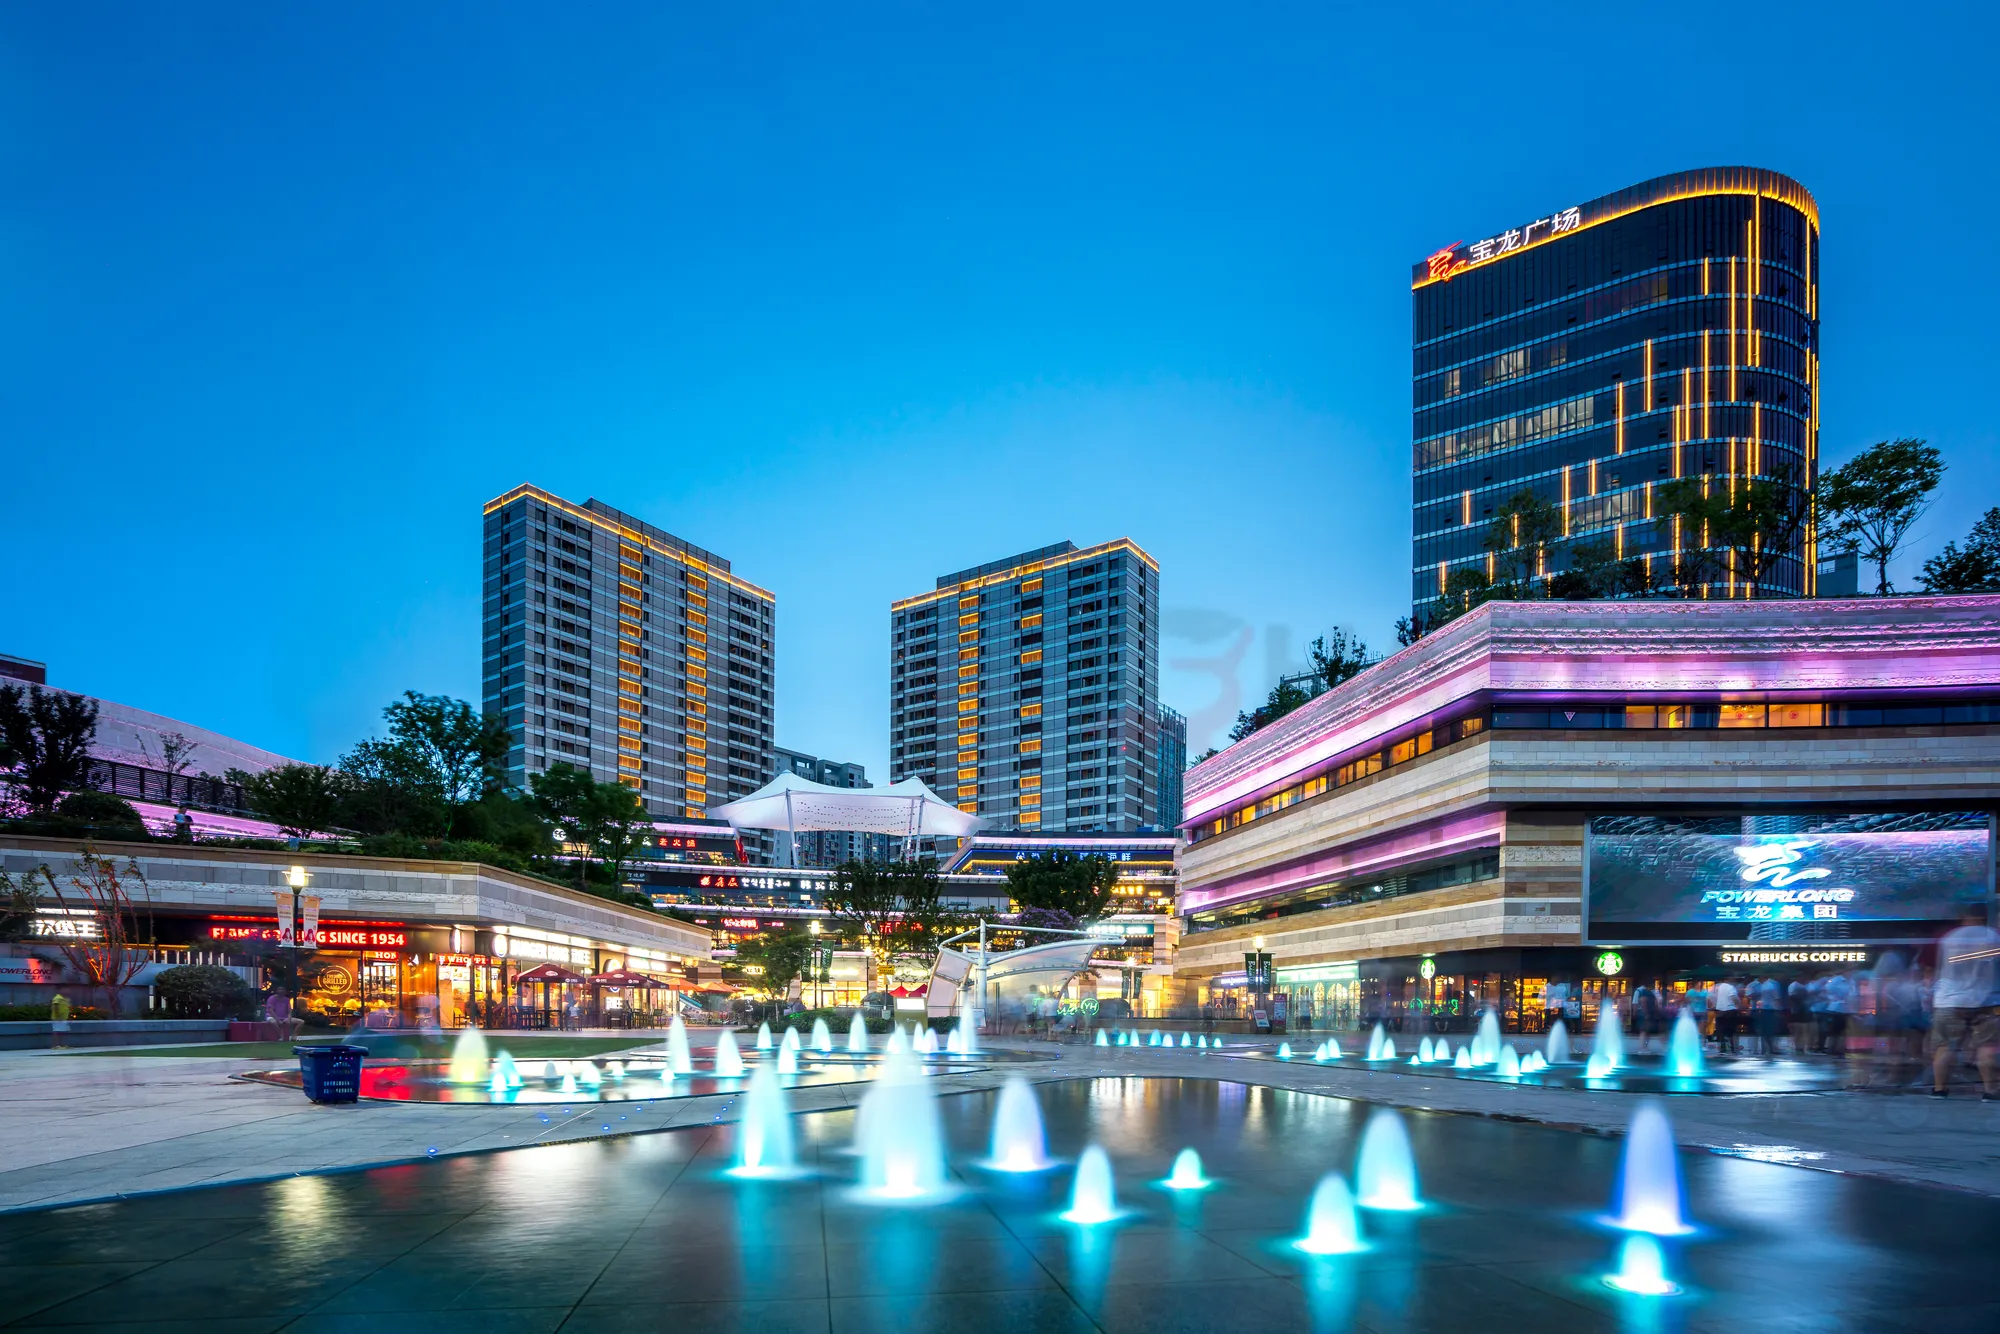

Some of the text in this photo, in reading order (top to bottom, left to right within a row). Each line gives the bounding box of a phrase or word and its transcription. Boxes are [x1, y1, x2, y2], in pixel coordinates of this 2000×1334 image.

[1470, 206, 1580, 265] 宝龙广场
[1700, 889, 1854, 904] POWERLONG
[1715, 904, 1838, 919] 宝龙集团
[329, 931, 367, 944] SINCE
[370, 933, 405, 946] 1954
[1722, 952, 1866, 963] STARBUCKS COFFEE
[0, 967, 52, 975] OWERLONG
